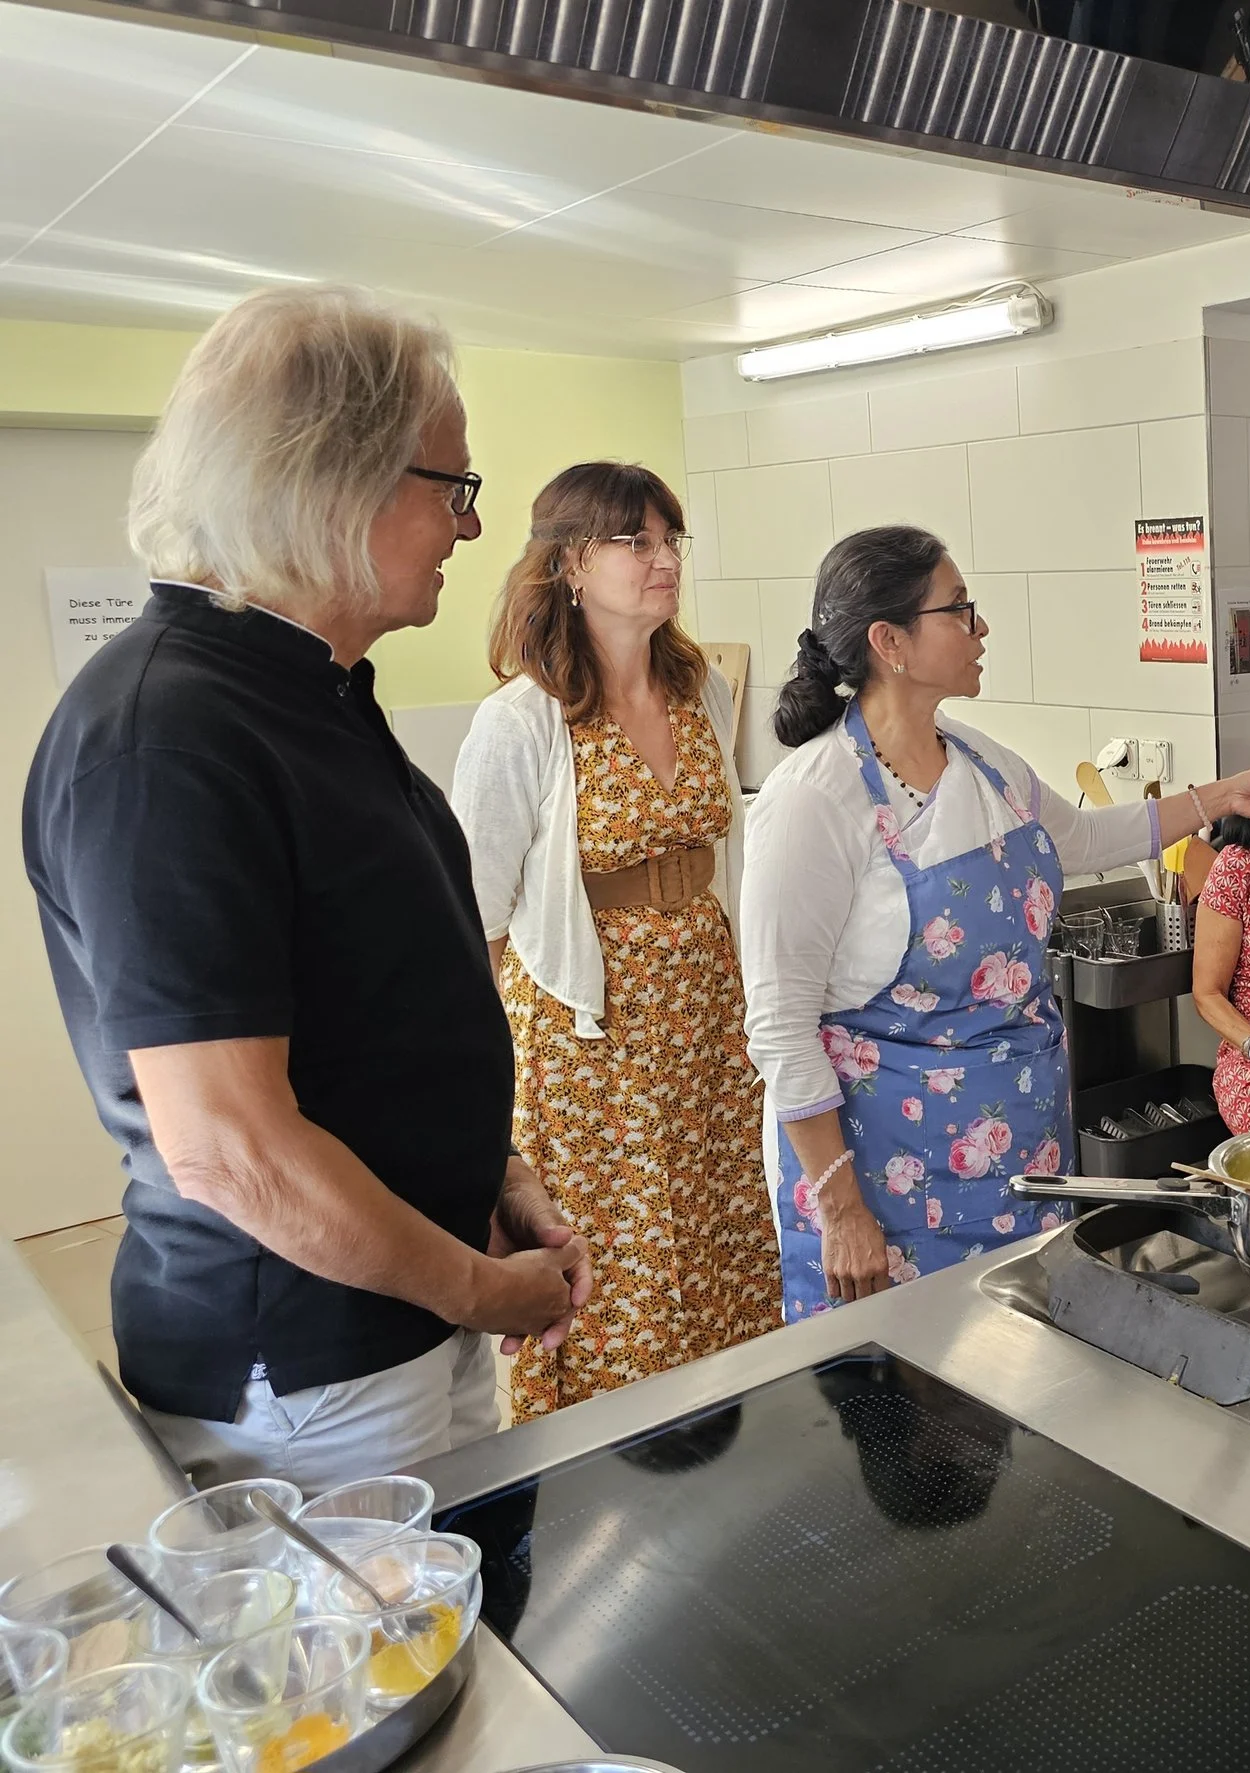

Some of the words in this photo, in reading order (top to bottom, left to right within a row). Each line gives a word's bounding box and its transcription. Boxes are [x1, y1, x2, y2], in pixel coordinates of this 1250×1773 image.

[1138, 523, 1144, 534] Es
[1145, 522, 1165, 534] brennt
[1172, 523, 1185, 532] was
[1186, 520, 1201, 532] tun?
[1146, 556, 1172, 564] Feuerwehr
[1140, 562, 1145, 577] 1
[1146, 565, 1173, 573] alarmieren
[1141, 581, 1147, 595] 2
[1147, 583, 1170, 591] Personen
[69, 599, 101, 608] Diese
[106, 598, 133, 607] Türe
[1142, 599, 1148, 613] 3
[1148, 600, 1162, 609] Türen
[1163, 600, 1187, 609] schliessen
[1142, 618, 1148, 632] 4
[1149, 619, 1163, 627] Brand
[1164, 619, 1192, 629] bekämpfen
[85, 633, 97, 641] zu
